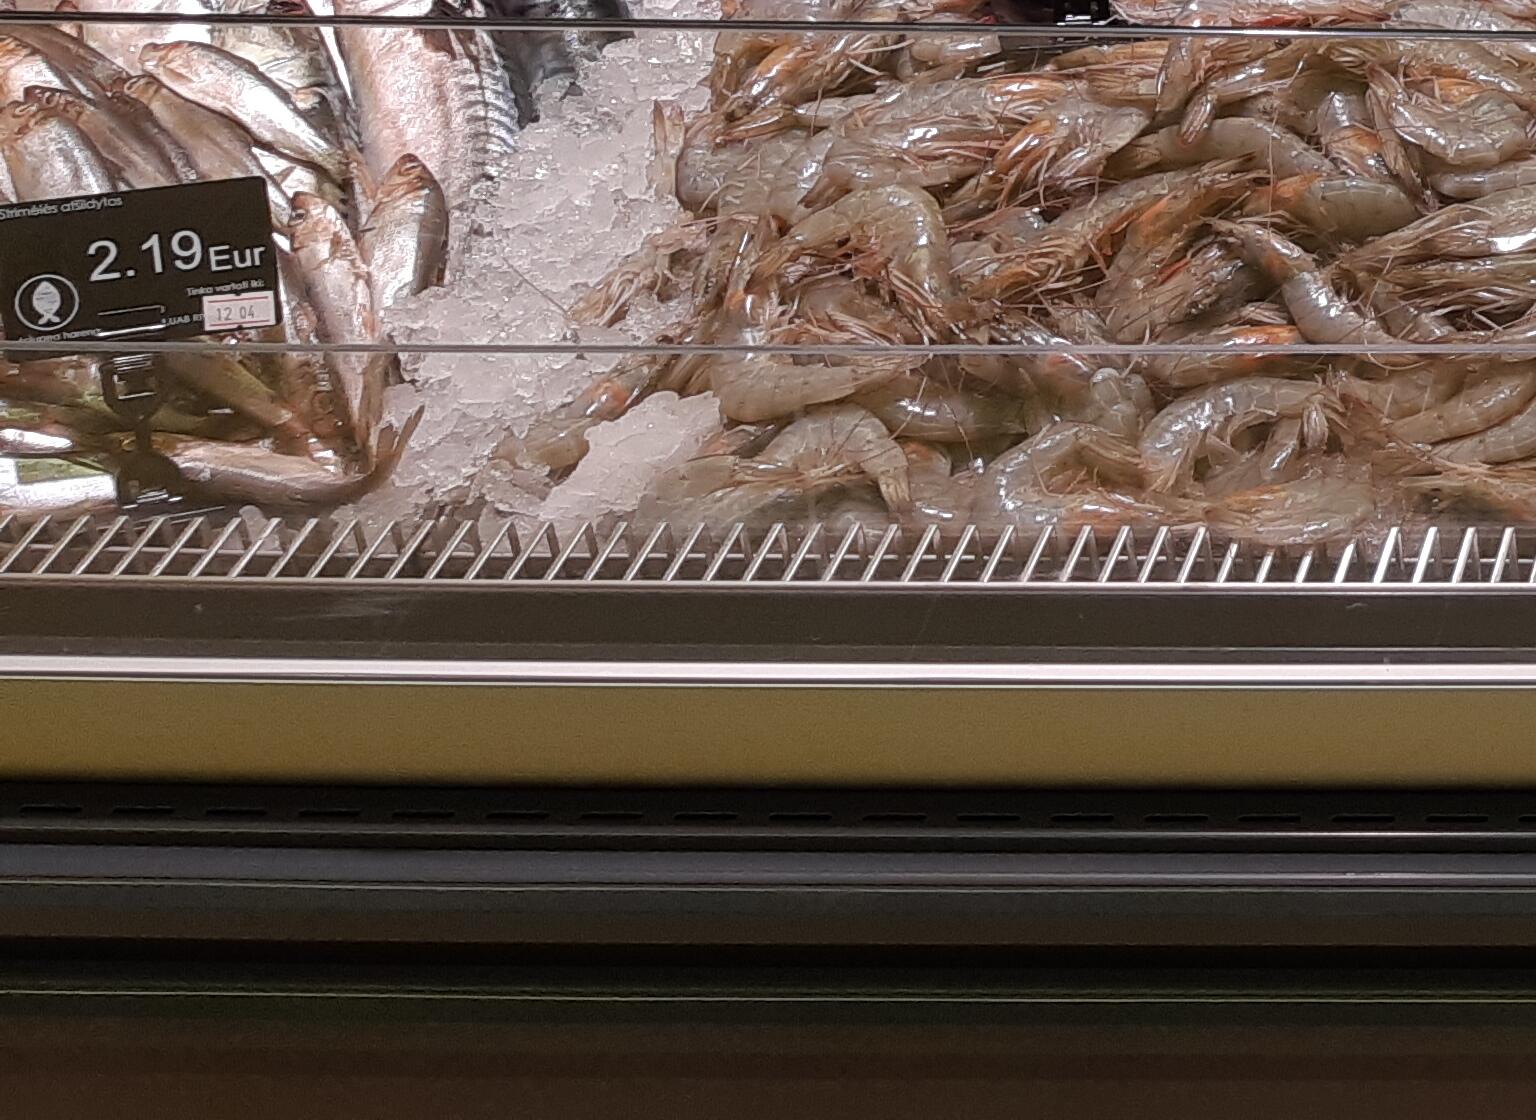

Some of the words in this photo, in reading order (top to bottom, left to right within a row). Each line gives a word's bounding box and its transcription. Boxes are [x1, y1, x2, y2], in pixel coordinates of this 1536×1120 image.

[87, 230, 202, 282] 2.19
[208, 245, 266, 272] Eur
[217, 306, 232, 321] 12
[239, 304, 255, 319] 04
